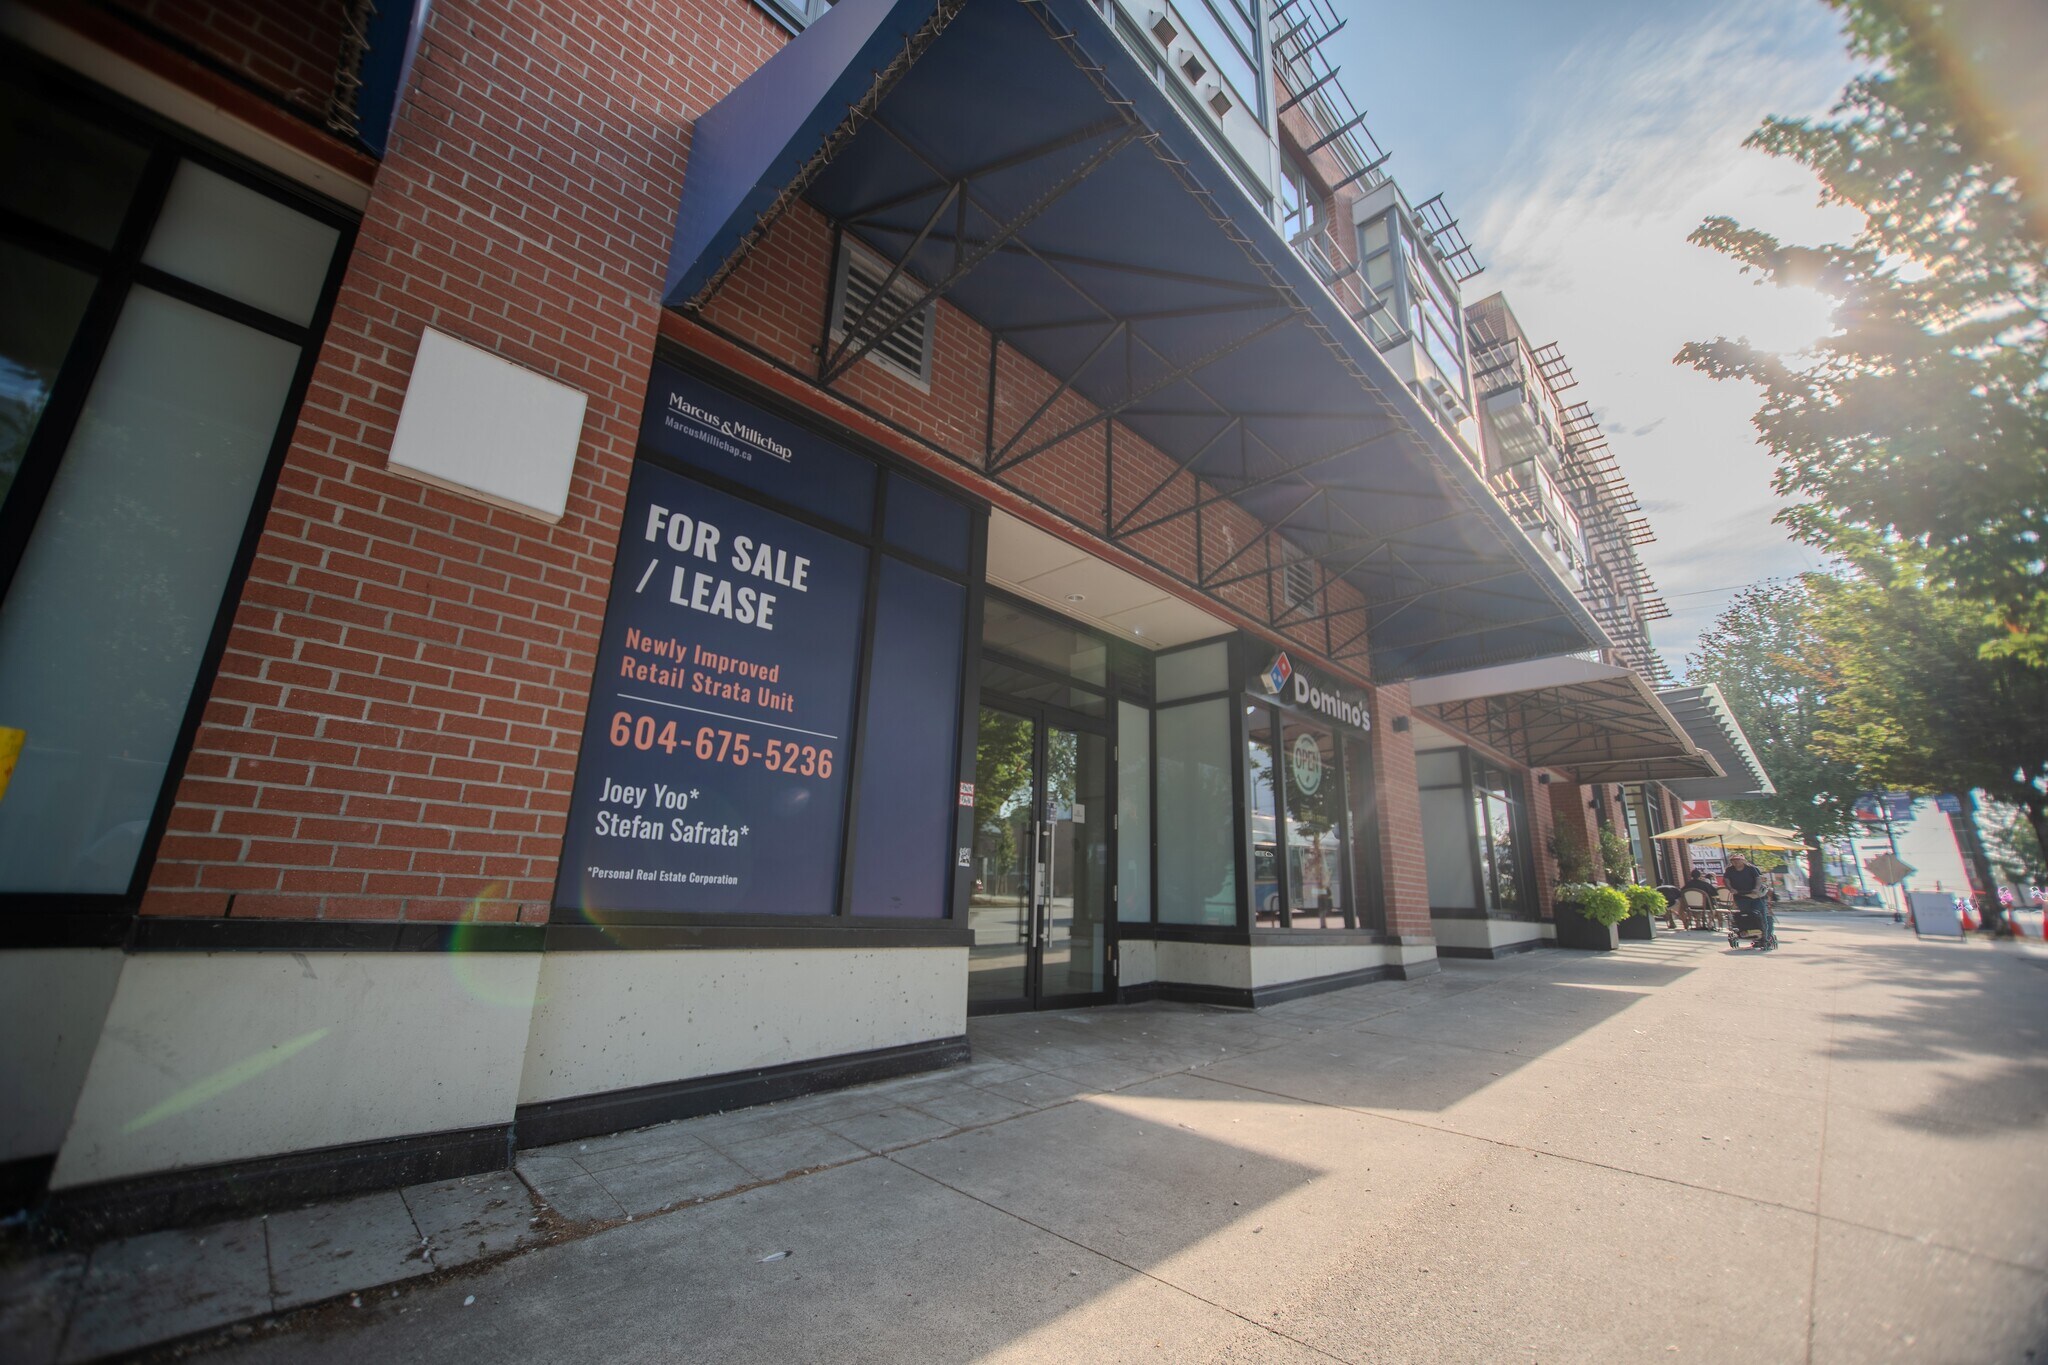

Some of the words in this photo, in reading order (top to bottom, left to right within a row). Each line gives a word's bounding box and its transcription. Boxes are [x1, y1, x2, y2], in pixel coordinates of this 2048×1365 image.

[665, 415, 752, 462] MarcusMillichap.ca
[669, 392, 720, 425] Marcus
[721, 421, 734, 438] &
[734, 421, 793, 460] Millichap
[645, 503, 721, 563] FOR
[731, 535, 811, 593] SALE
[635, 558, 659, 594] /
[669, 565, 777, 631] LEASE
[620, 655, 685, 689] Retail
[691, 671, 751, 704] Strata
[757, 687, 795, 713] Unit
[625, 627, 687, 664] Newly
[694, 644, 780, 684] Improved
[1294, 672, 1371, 732] Domino's
[609, 711, 834, 779] 604-675-5236
[1295, 747, 1319, 774] OPEN
[599, 777, 647, 809] Joey
[595, 810, 664, 841] Stefan
[636, 868, 657, 881] Real
[659, 870, 687, 883] Estate
[689, 872, 738, 885] Corporation
